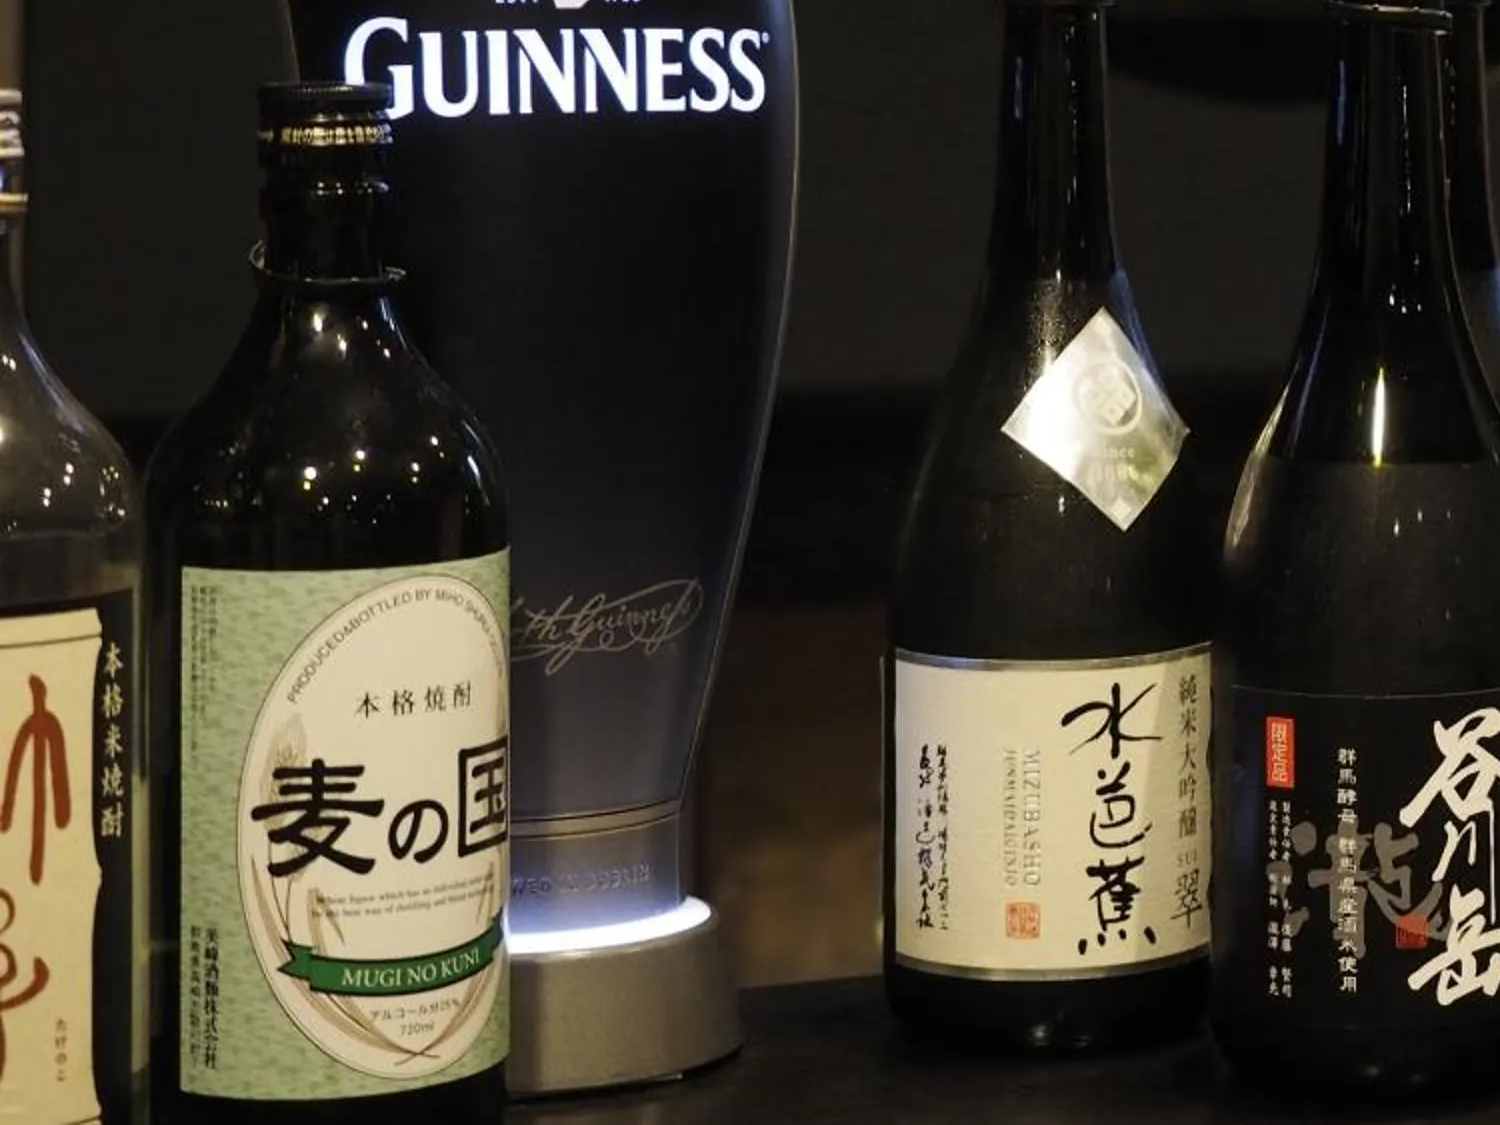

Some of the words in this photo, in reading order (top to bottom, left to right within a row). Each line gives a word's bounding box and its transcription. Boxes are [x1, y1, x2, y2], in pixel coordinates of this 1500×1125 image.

[343, 16, 766, 120] GUINNESS
[415, 588, 431, 602] BY
[101, 642, 125, 838] 本格米焼酎
[355, 680, 471, 719] 本格焼酎
[251, 735, 509, 878] 麦の国
[1023, 749, 1041, 887] MIZUBASHO
[341, 967, 402, 988] MUGI
[407, 963, 437, 985] NO
[441, 946, 481, 979] KUNI
